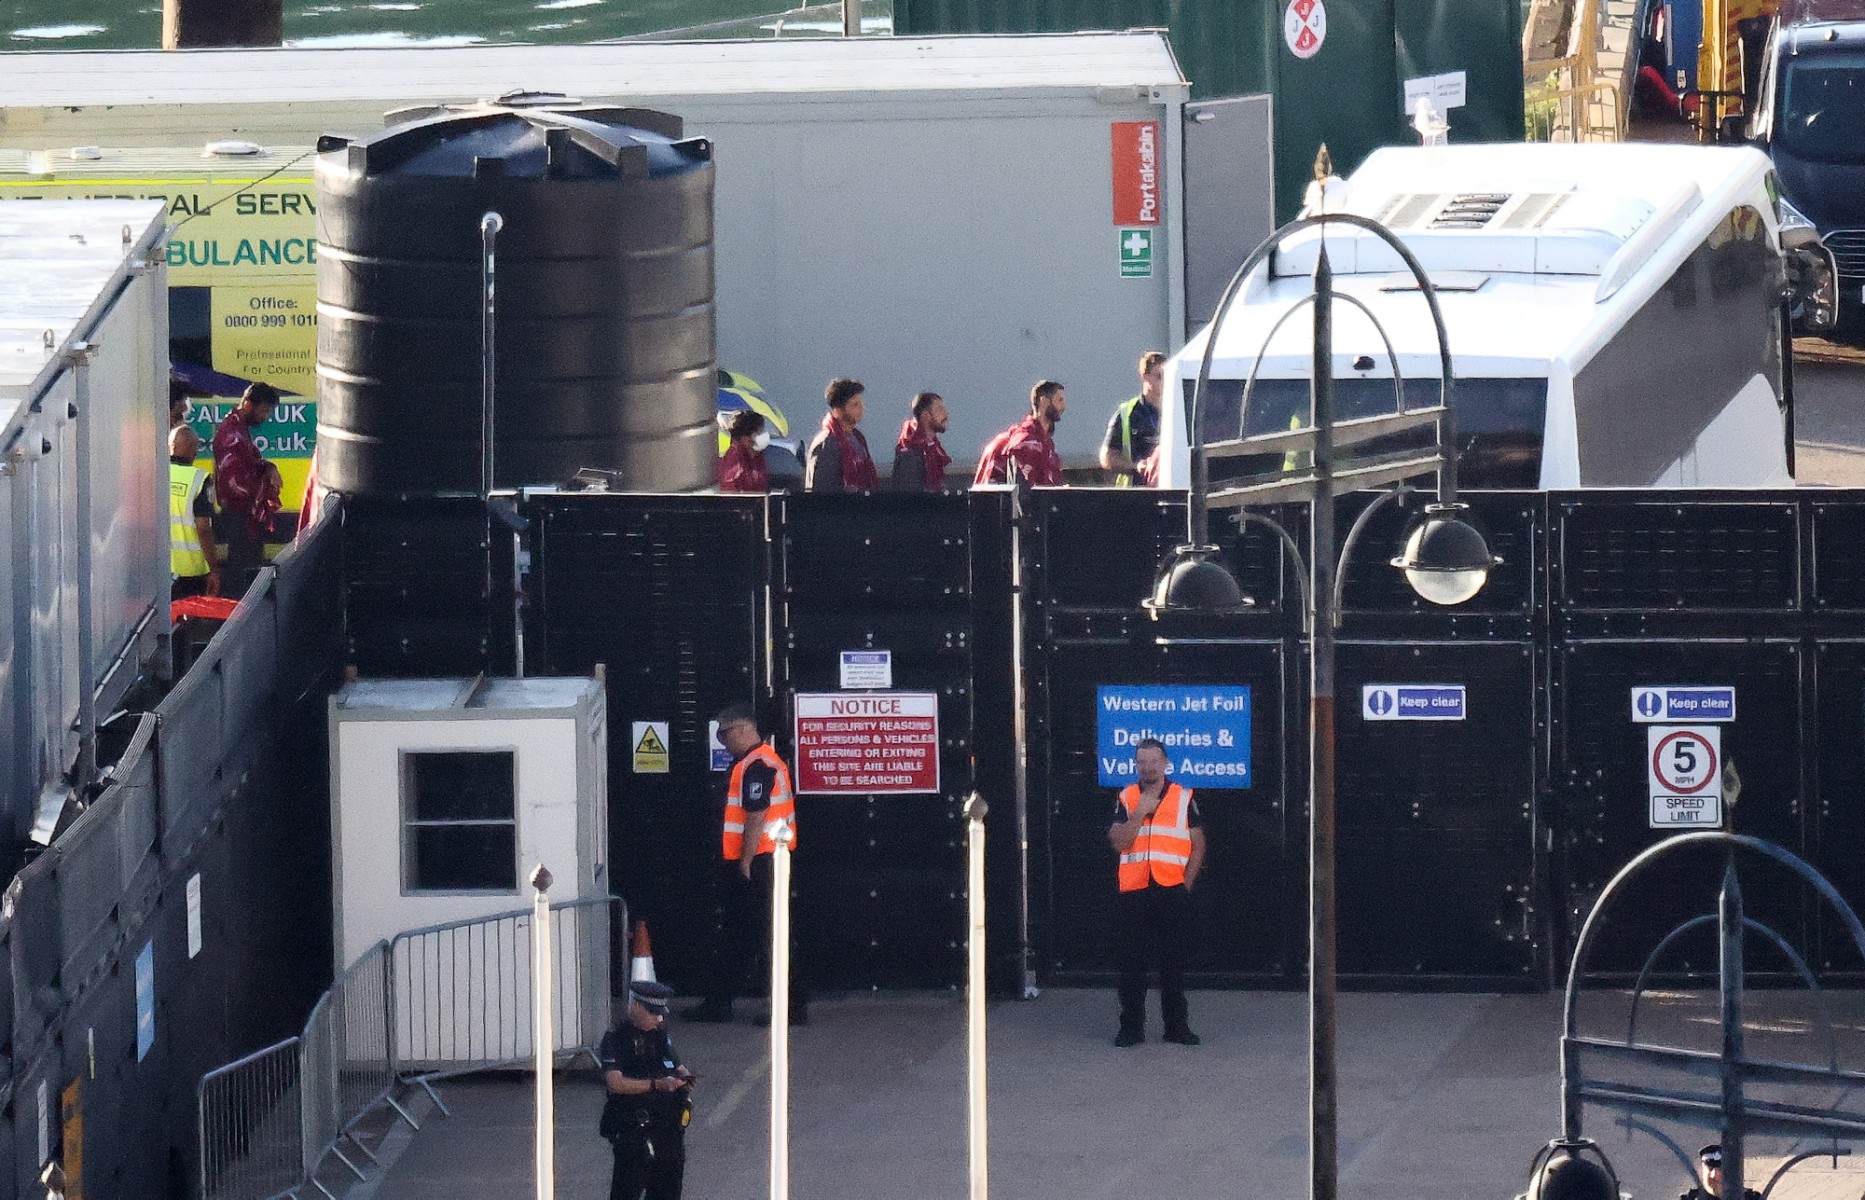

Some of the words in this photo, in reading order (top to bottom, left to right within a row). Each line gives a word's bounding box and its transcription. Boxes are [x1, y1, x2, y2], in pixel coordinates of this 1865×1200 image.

[1292, 20, 1299, 33] J
[1312, 15, 1319, 28] J
[1138, 125, 1156, 222] Portakabin
[249, 297, 298, 310] Office:
[225, 315, 258, 328] 0800
[261, 314, 286, 328] 999
[831, 700, 902, 714] NOTICE
[1103, 695, 1176, 711] Western
[1181, 696, 1208, 712] Jet
[1213, 695, 1244, 711] Foil
[1400, 696, 1428, 709] Keep
[1431, 696, 1460, 707] clear
[1669, 698, 1698, 710] Keep
[1701, 698, 1730, 709] clear
[802, 722, 823, 731] FOR
[826, 721, 877, 731] SECURITY
[880, 721, 932, 731] REASONS
[800, 736, 818, 745] ALL
[821, 735, 870, 744] PERSONS
[872, 735, 881, 744] &
[884, 734, 936, 744] VEHICLES
[1113, 729, 1212, 747] Deliveries
[1217, 729, 1234, 747] &
[809, 748, 861, 758] ENTERING
[864, 748, 880, 758] OR
[883, 748, 926, 758] EXITING
[1673, 741, 1696, 773] 5
[813, 762, 836, 771] THIS
[838, 762, 861, 771] SITE
[864, 762, 885, 771] ARE
[887, 761, 924, 771] LIABLE
[1180, 758, 1247, 776] Access
[823, 775, 839, 785] TO
[840, 775, 854, 785] BE
[856, 775, 912, 785] SEARCHED
[1666, 798, 1705, 809] SPEED
[1671, 811, 1700, 821] LIMIT
